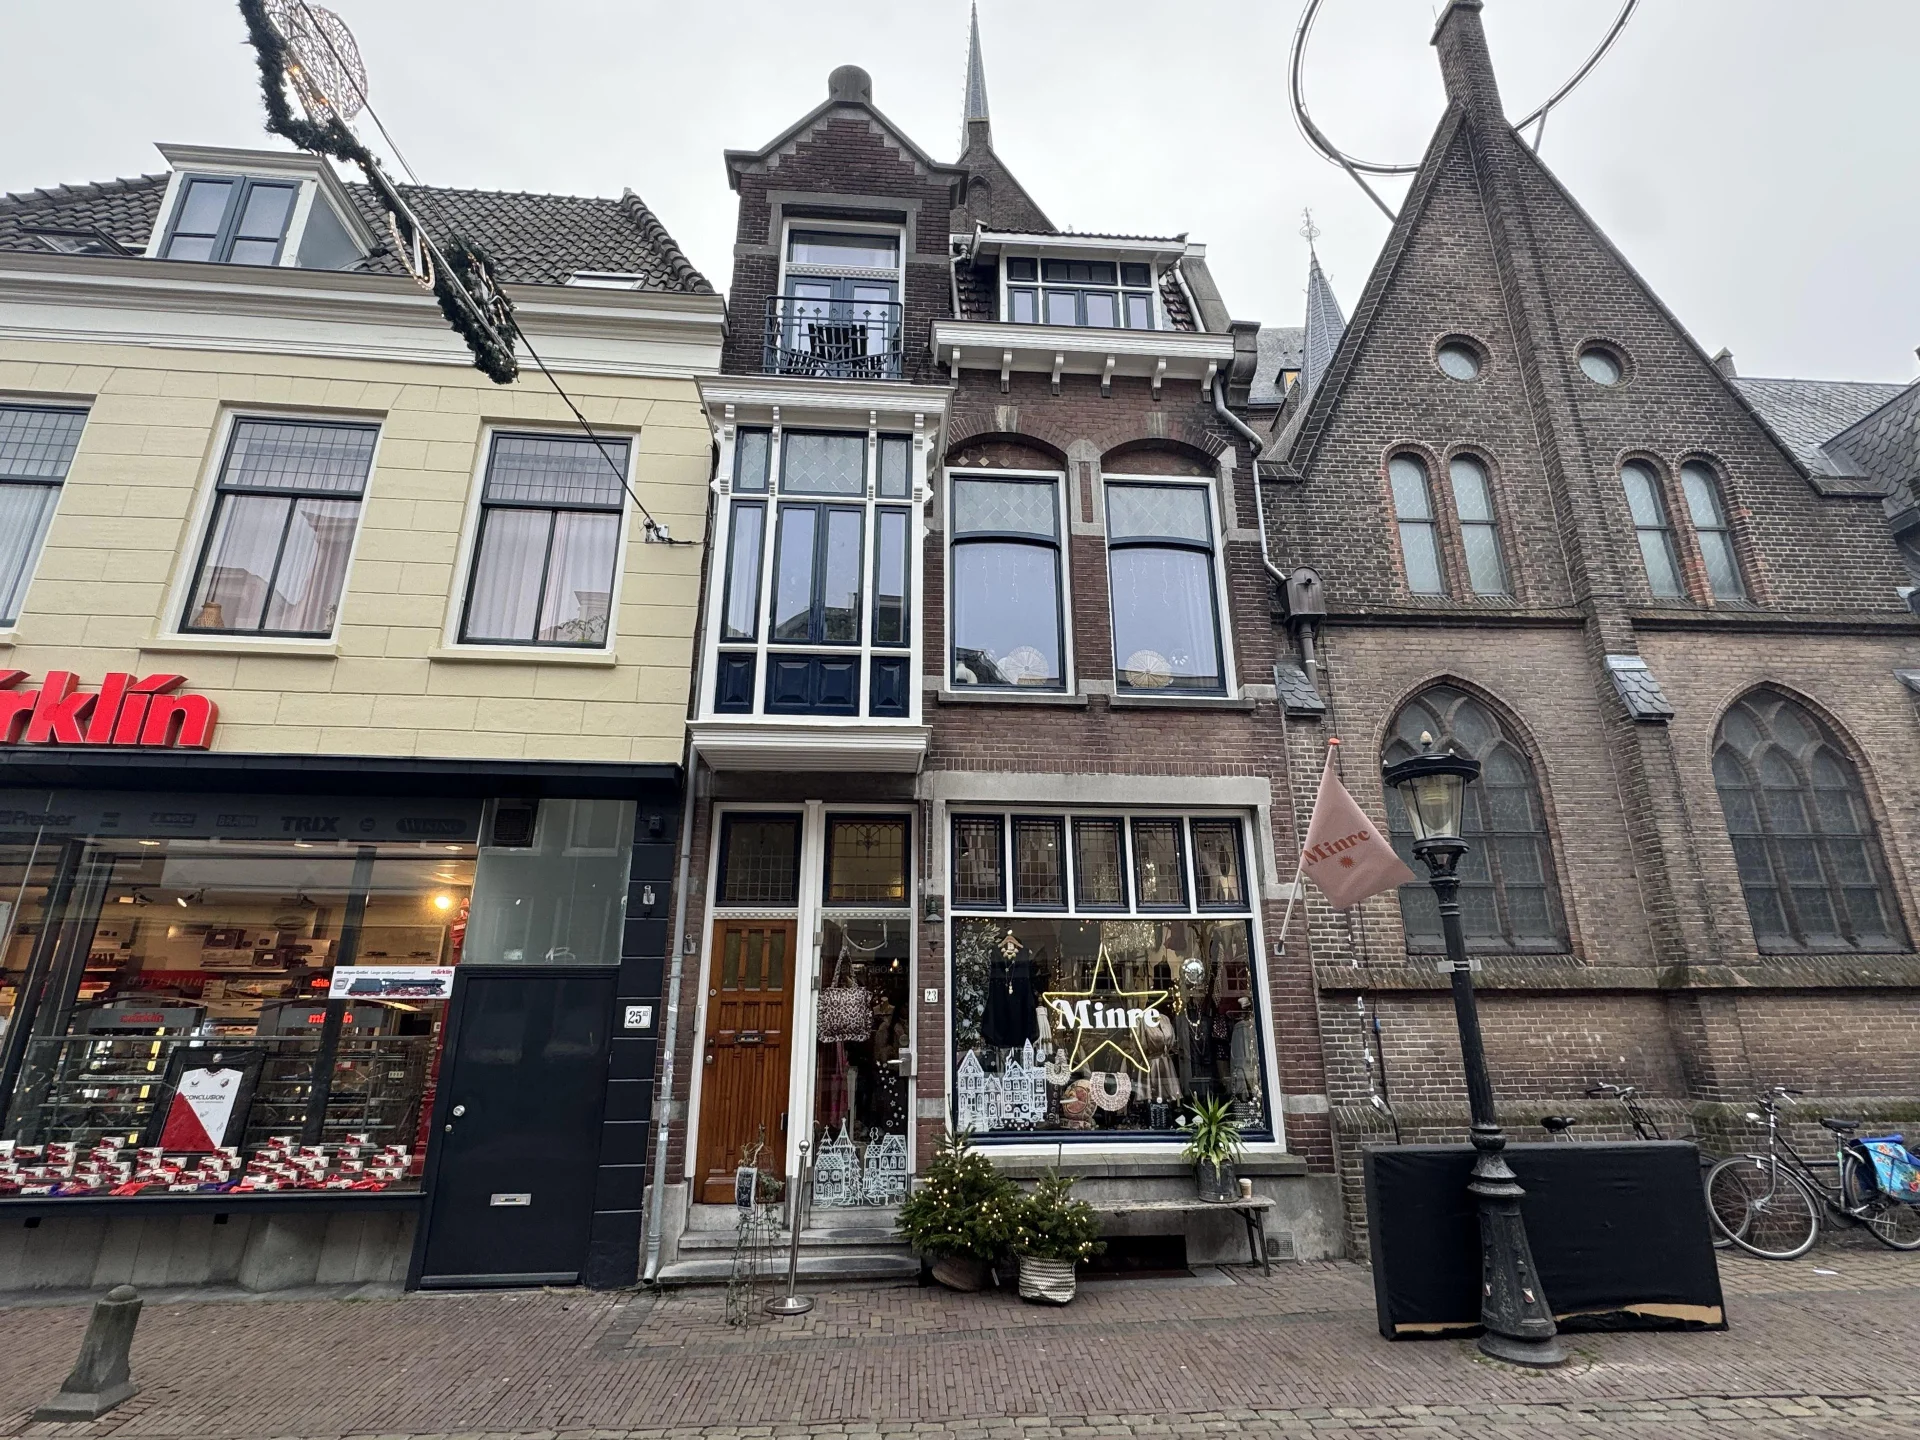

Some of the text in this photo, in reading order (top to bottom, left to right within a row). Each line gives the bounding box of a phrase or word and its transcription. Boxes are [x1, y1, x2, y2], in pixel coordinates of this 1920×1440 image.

[0, 669, 218, 750] rklin
[281, 816, 340, 832] TRIX
[1304, 831, 1370, 866] Minre
[926, 990, 937, 1001] 23
[628, 1010, 642, 1024] 25
[1052, 999, 1160, 1029] Minre
